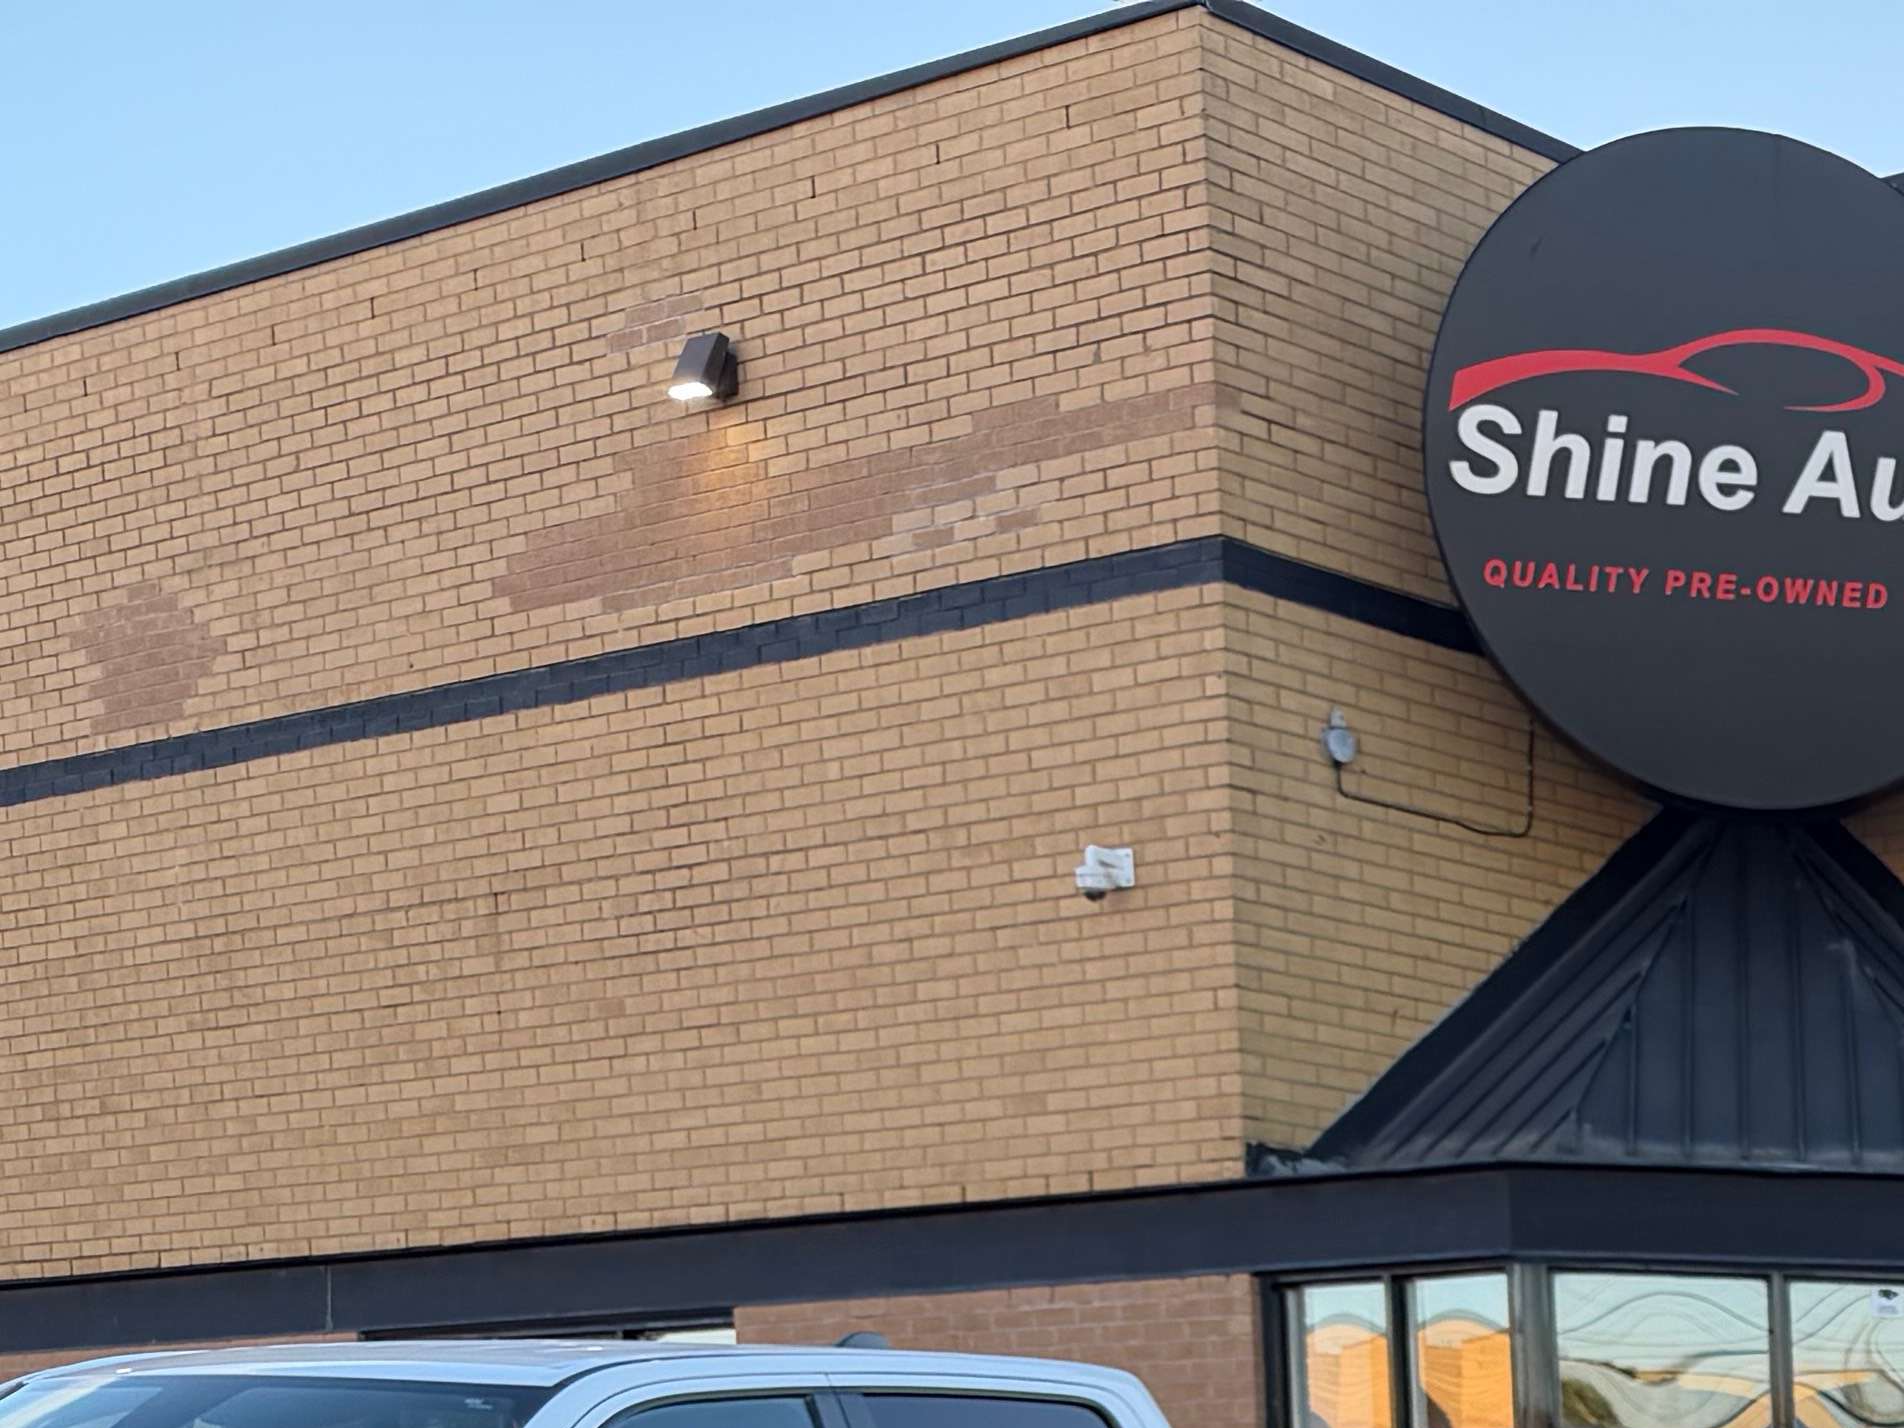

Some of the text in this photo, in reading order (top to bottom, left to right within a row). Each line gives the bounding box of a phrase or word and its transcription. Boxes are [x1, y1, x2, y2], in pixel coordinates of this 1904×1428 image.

[1448, 403, 1758, 512] Shine
[1483, 557, 1651, 595] QUALITY
[1665, 570, 1890, 611] PRE-OWNED
